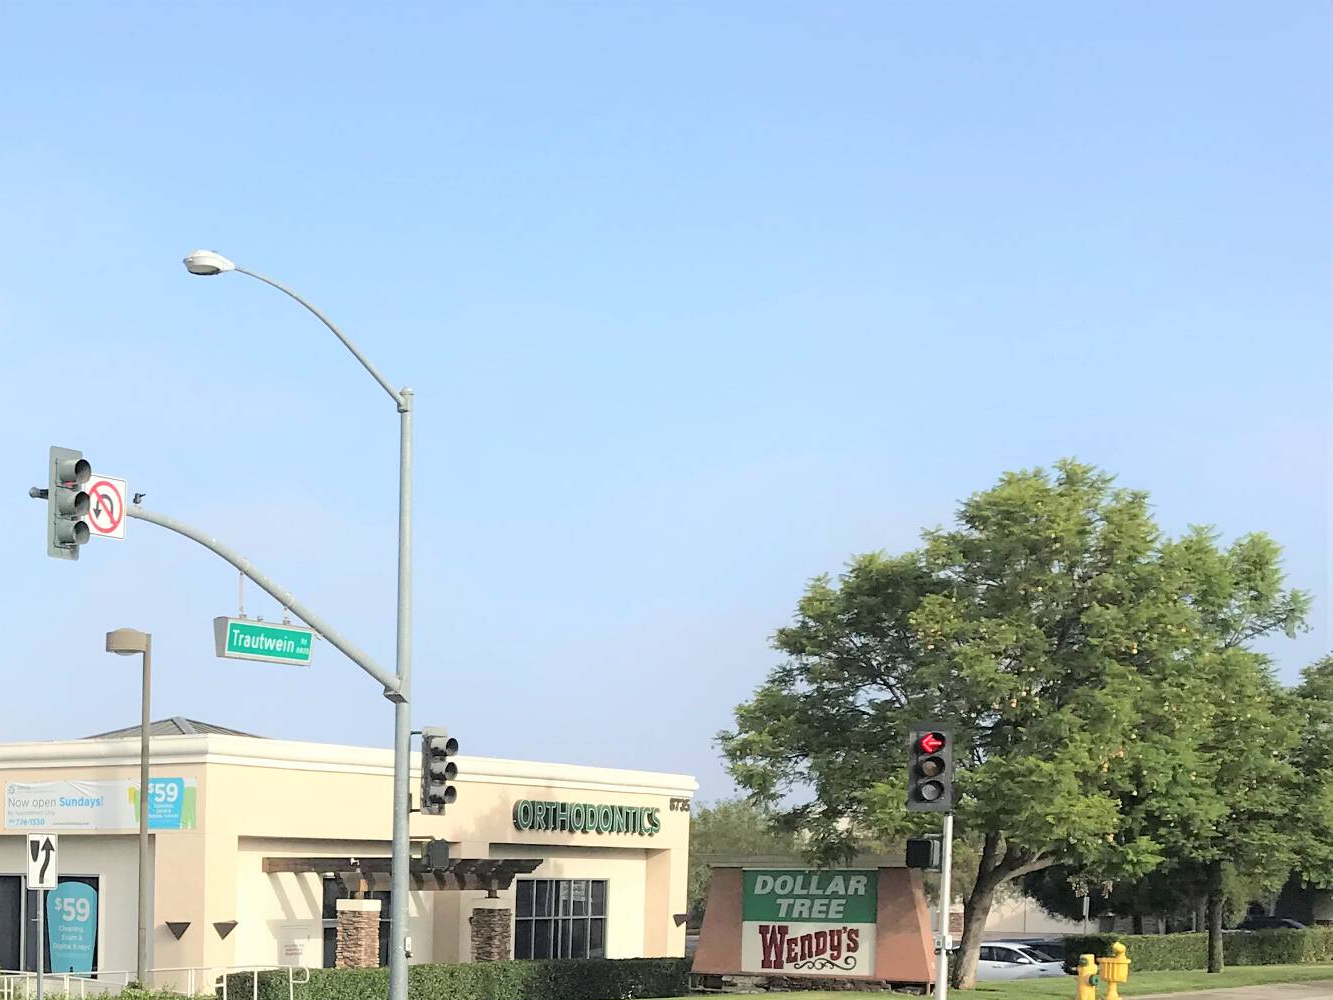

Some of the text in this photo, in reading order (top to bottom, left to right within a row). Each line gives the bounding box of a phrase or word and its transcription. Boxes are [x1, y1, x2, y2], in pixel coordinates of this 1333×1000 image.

[232, 629, 295, 653] Trautwein
[8, 796, 104, 809] Now open Sundays!
[148, 782, 179, 803] $59
[513, 799, 661, 836] ORTHODONTICS
[754, 875, 868, 896] DOLLAR
[54, 896, 91, 923] $59
[776, 898, 847, 919] TREE
[758, 924, 860, 970] Wendy's
